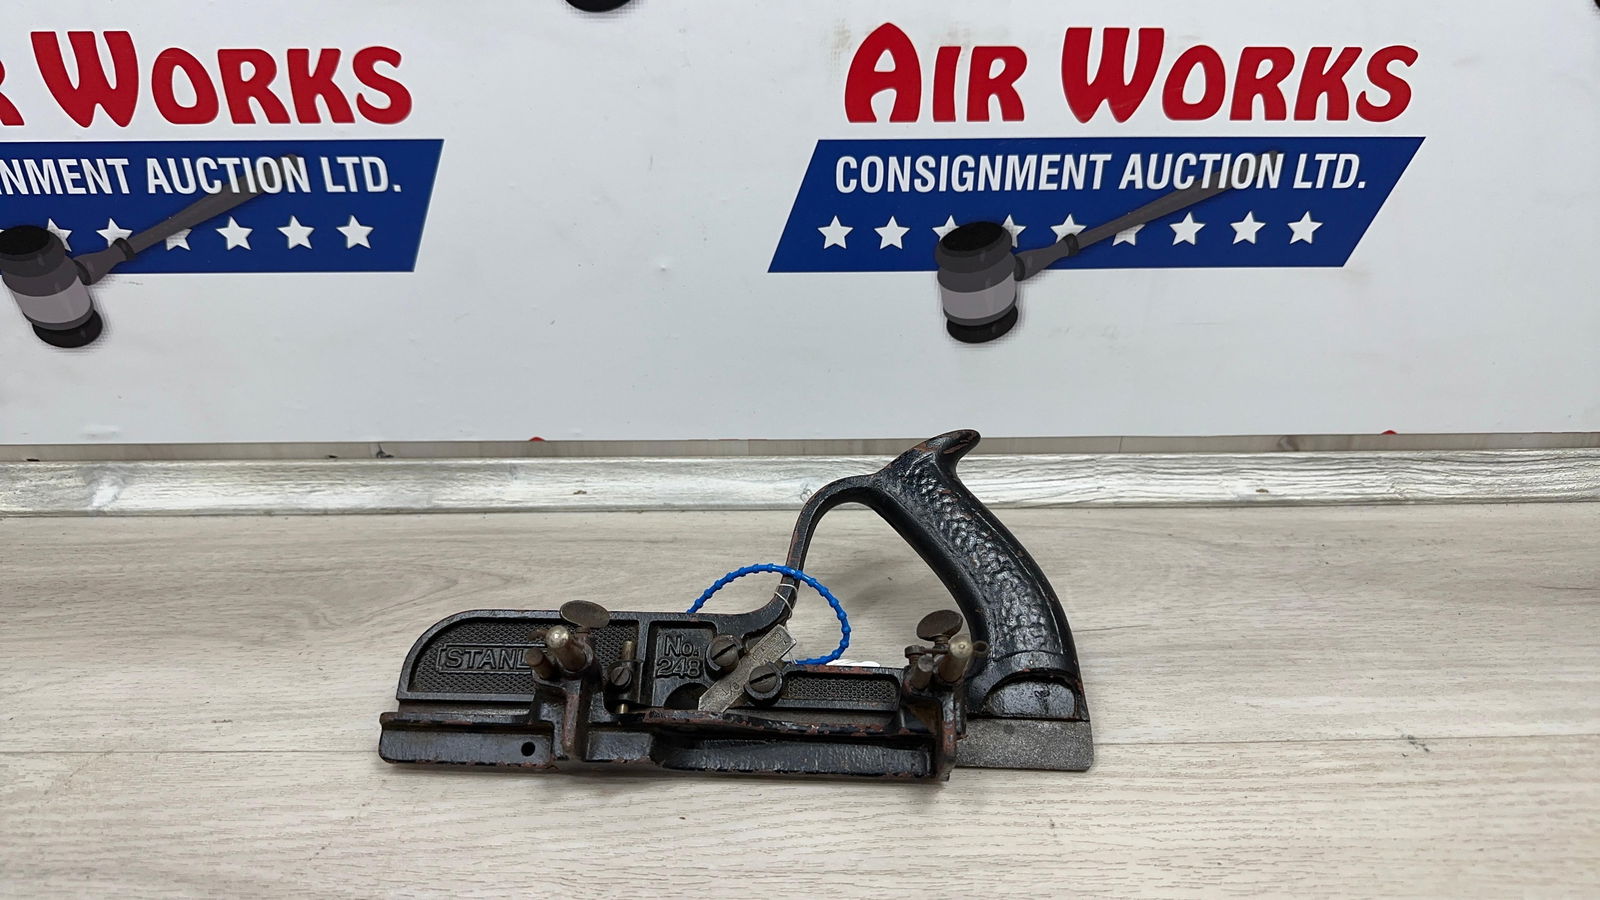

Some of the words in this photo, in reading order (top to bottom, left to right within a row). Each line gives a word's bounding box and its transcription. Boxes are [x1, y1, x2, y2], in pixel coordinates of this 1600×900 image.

[30, 30, 412, 128] WORKS
[844, 22, 1028, 123] AIR
[1061, 26, 1419, 123] WORKS
[0, 158, 130, 195] NMENT
[147, 156, 311, 195] AUCTION
[321, 156, 402, 193] LTD.
[835, 153, 1112, 194] CONSIGNMENT
[1118, 152, 1285, 190] AUCTION
[1292, 153, 1367, 189] LTD.
[445, 648, 531, 670] STANL
[665, 635, 700, 657] No.
[657, 658, 701, 678] 248
